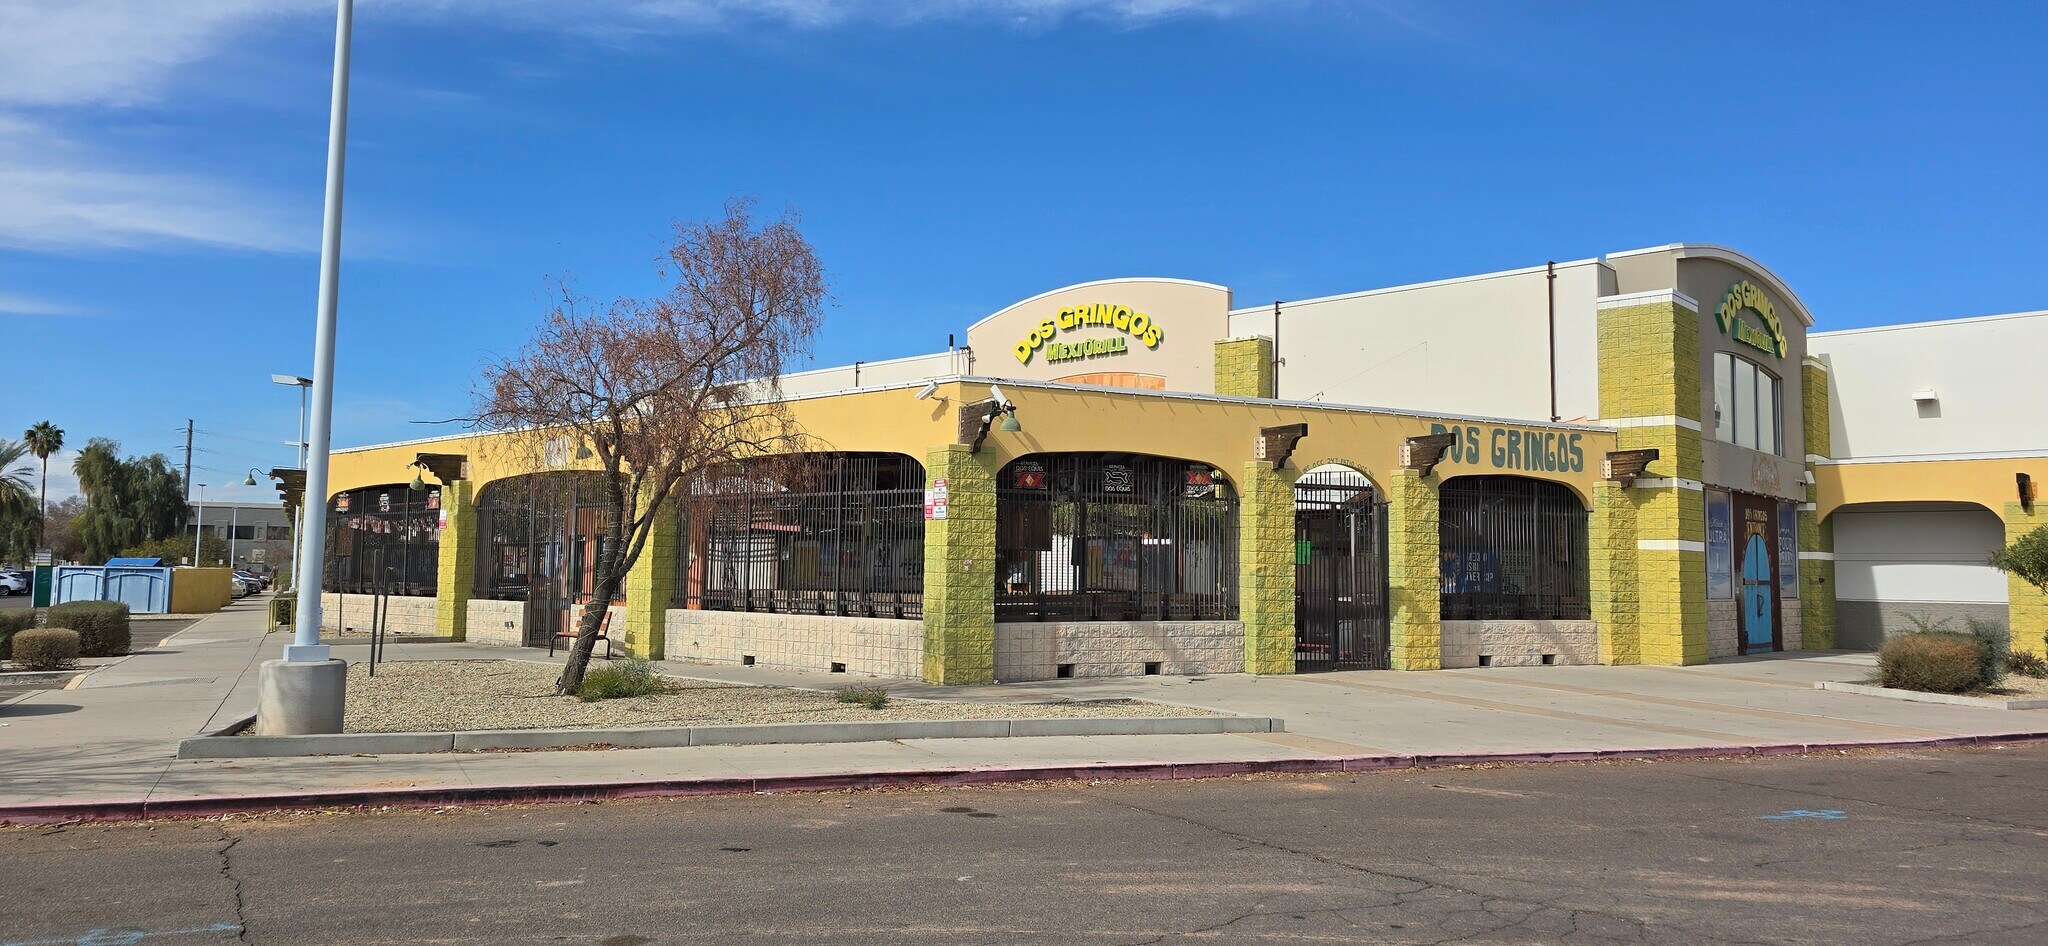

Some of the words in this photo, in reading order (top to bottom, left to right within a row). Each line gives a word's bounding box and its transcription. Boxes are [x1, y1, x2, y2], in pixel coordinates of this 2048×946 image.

[1013, 317, 1057, 365] DOS
[1056, 303, 1163, 349] GRINGOS
[1717, 283, 1743, 333] DOS
[1742, 280, 1788, 359] GRINGOS
[1491, 428, 1584, 473] GRINGOS
[1707, 529, 1728, 544] ULTRA
